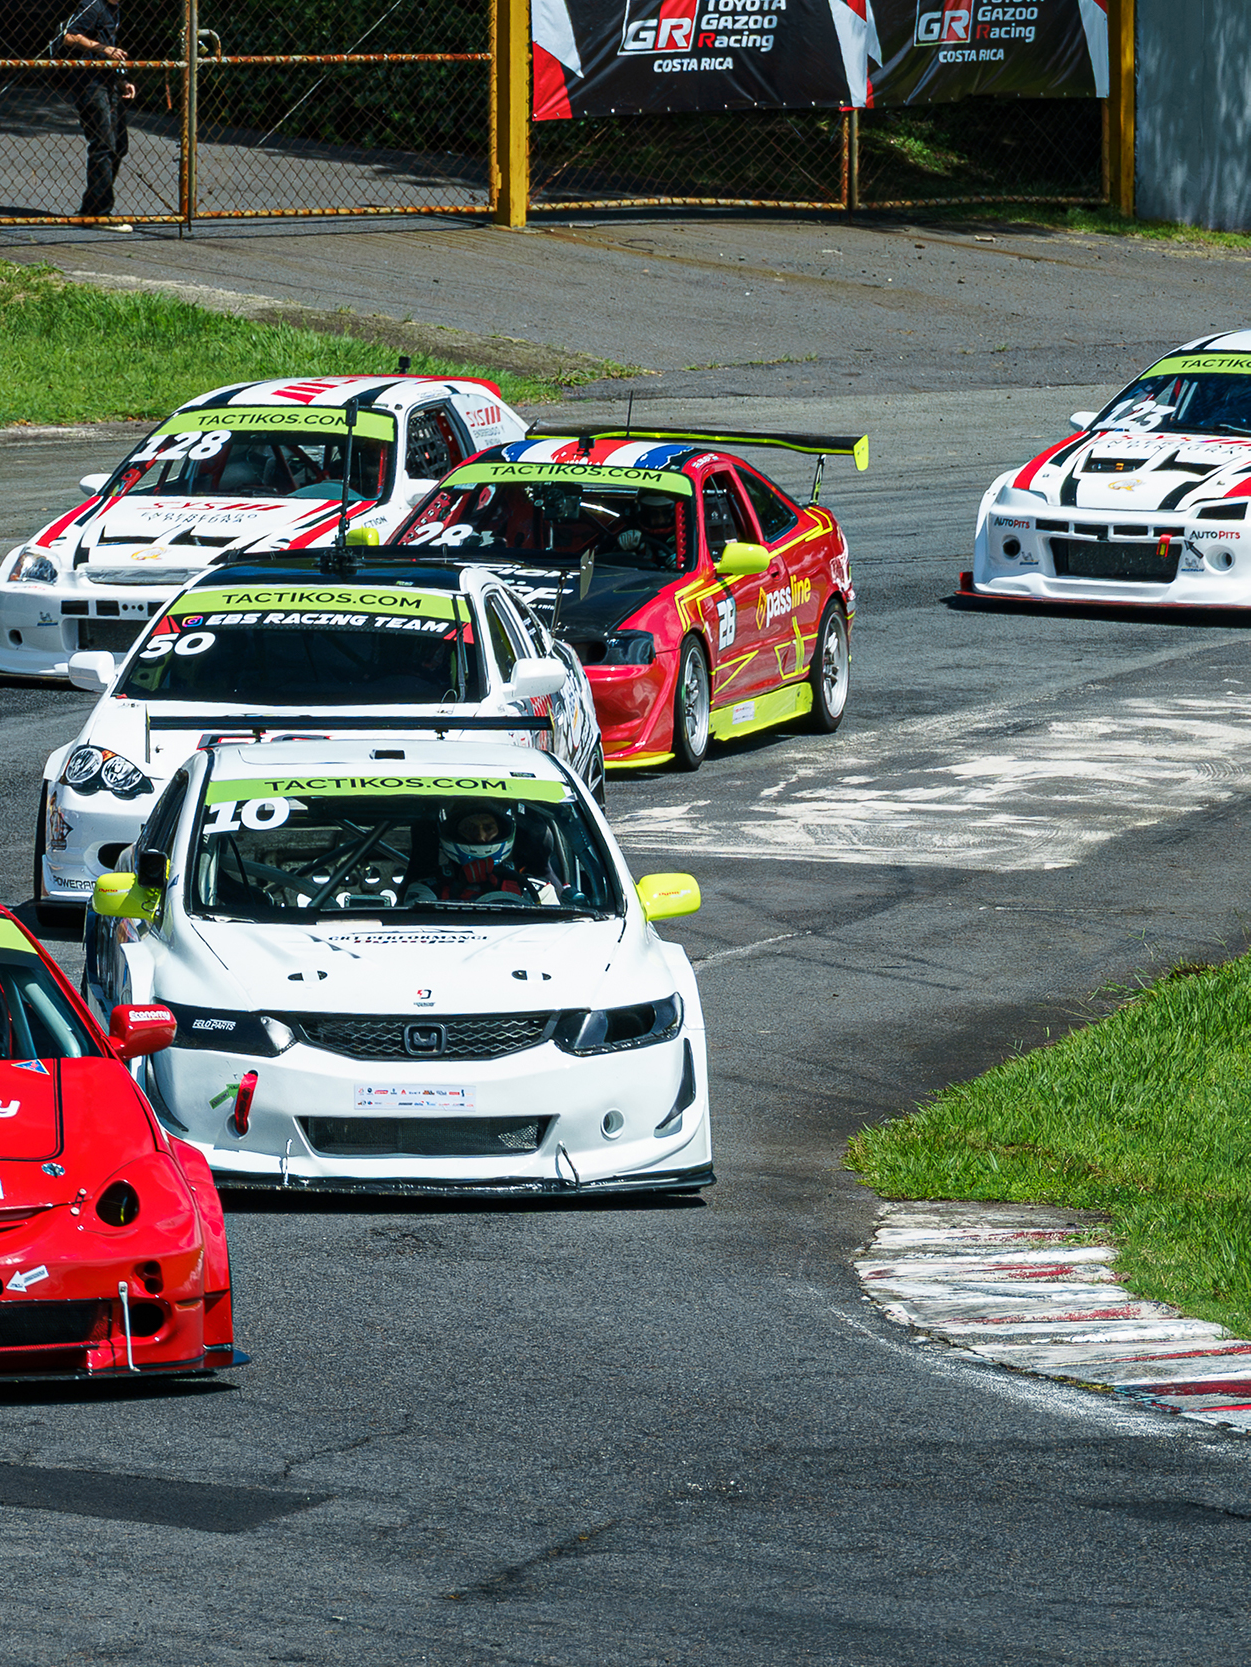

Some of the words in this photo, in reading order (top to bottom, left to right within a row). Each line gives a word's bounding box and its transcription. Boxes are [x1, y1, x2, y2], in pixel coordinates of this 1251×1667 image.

[707, 0, 787, 12] TOYOTA
[977, 6, 1038, 21] GAZOO
[701, 13, 778, 30] GAZOO
[918, 9, 969, 41] GR
[623, 17, 692, 50] GR
[698, 31, 775, 52] Racing
[976, 23, 1035, 43] Racing
[653, 58, 698, 73] COSTA
[700, 57, 734, 71] RICA
[938, 50, 977, 63] COSTA
[979, 49, 1004, 61] RICA
[129, 429, 232, 462] 128
[490, 463, 662, 483] TACTIKOS.COM
[406, 521, 473, 547] 28
[1189, 530, 1241, 541] AUTOPITS
[222, 591, 422, 609] TACTIKOS.COM
[766, 575, 811, 628] passline
[205, 613, 259, 625] EBS
[262, 612, 371, 627] RACING
[373, 615, 449, 633] TEAM
[139, 631, 216, 659] 50
[264, 777, 508, 792] TACTIKOS.COM
[204, 796, 290, 835] 10
[129, 1010, 170, 1022] Economy
